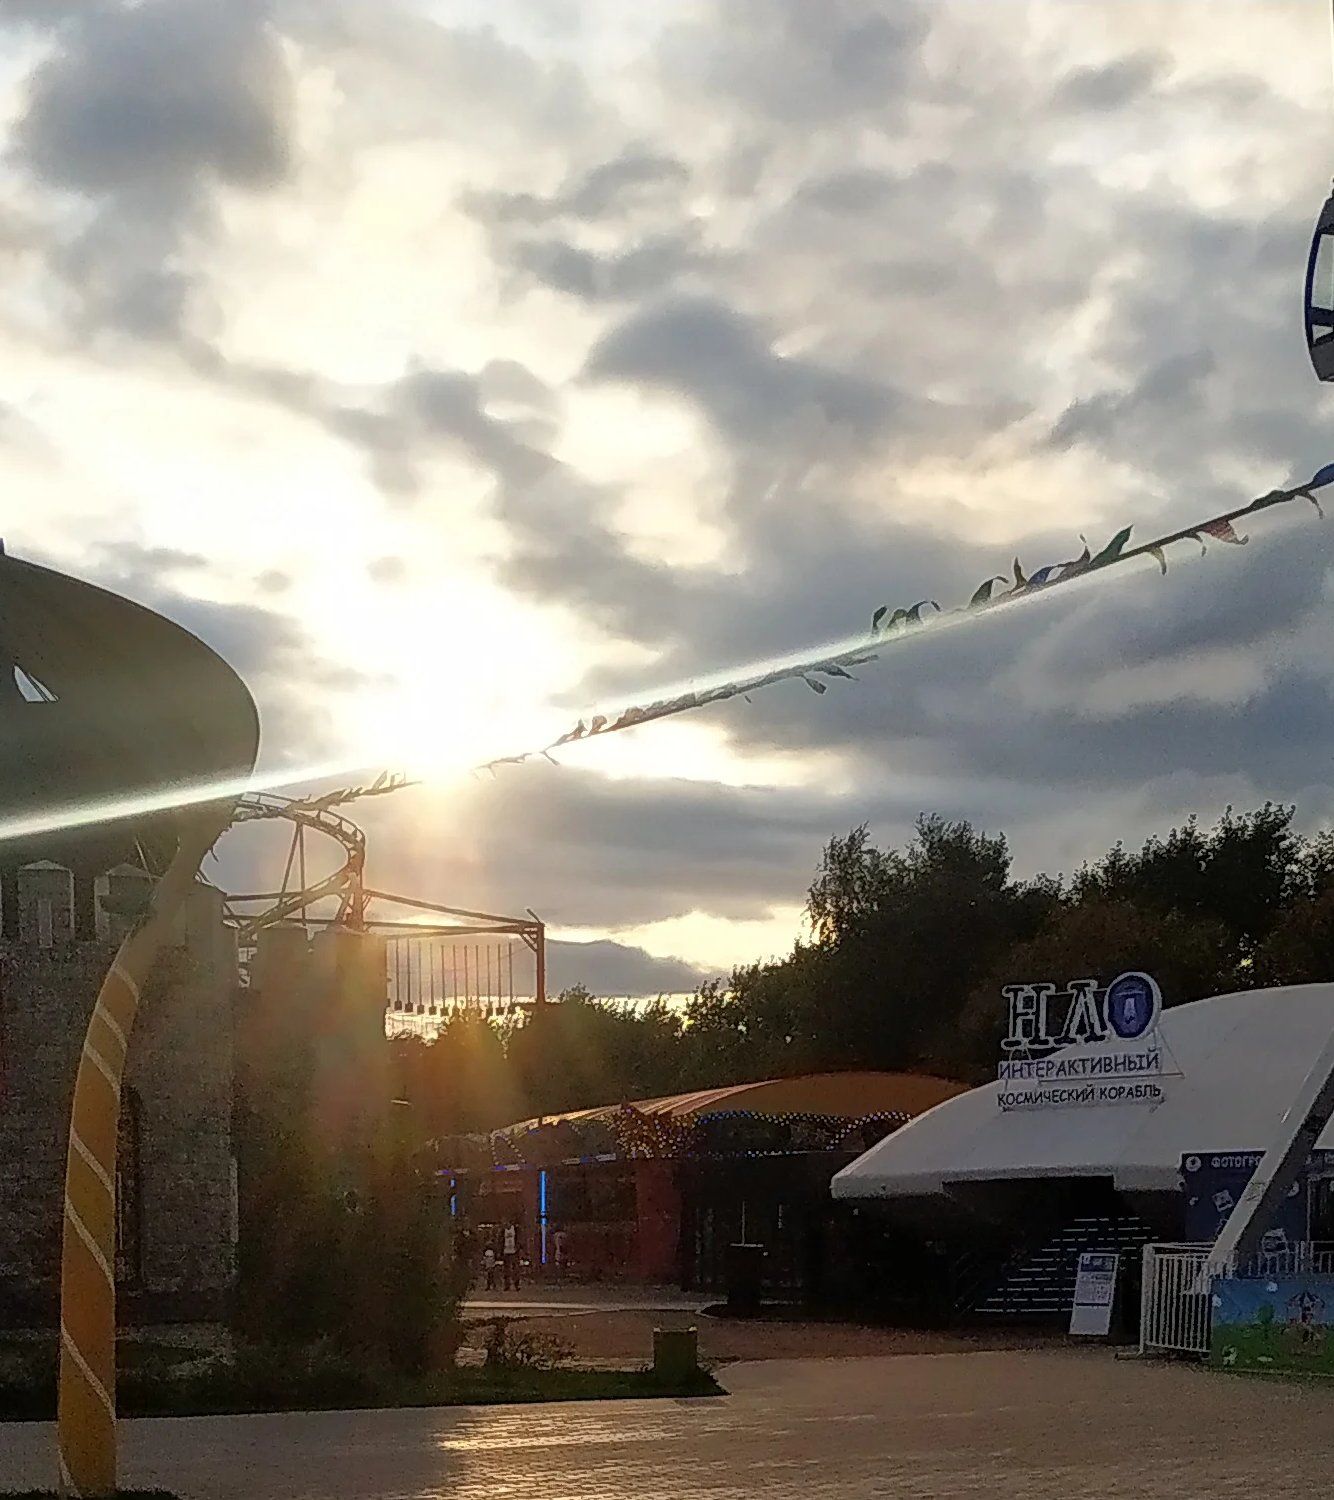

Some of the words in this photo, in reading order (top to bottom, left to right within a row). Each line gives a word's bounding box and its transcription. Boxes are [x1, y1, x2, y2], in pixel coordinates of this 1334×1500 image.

[1001, 971, 1162, 1050] НЛО
[999, 1048, 1160, 1079] ИНТЕРАКТИВНЫЙ
[997, 1084, 1095, 1107] КОСМИЧЕСКИЙ
[1099, 1084, 1161, 1100] КОРАБЛЬ
